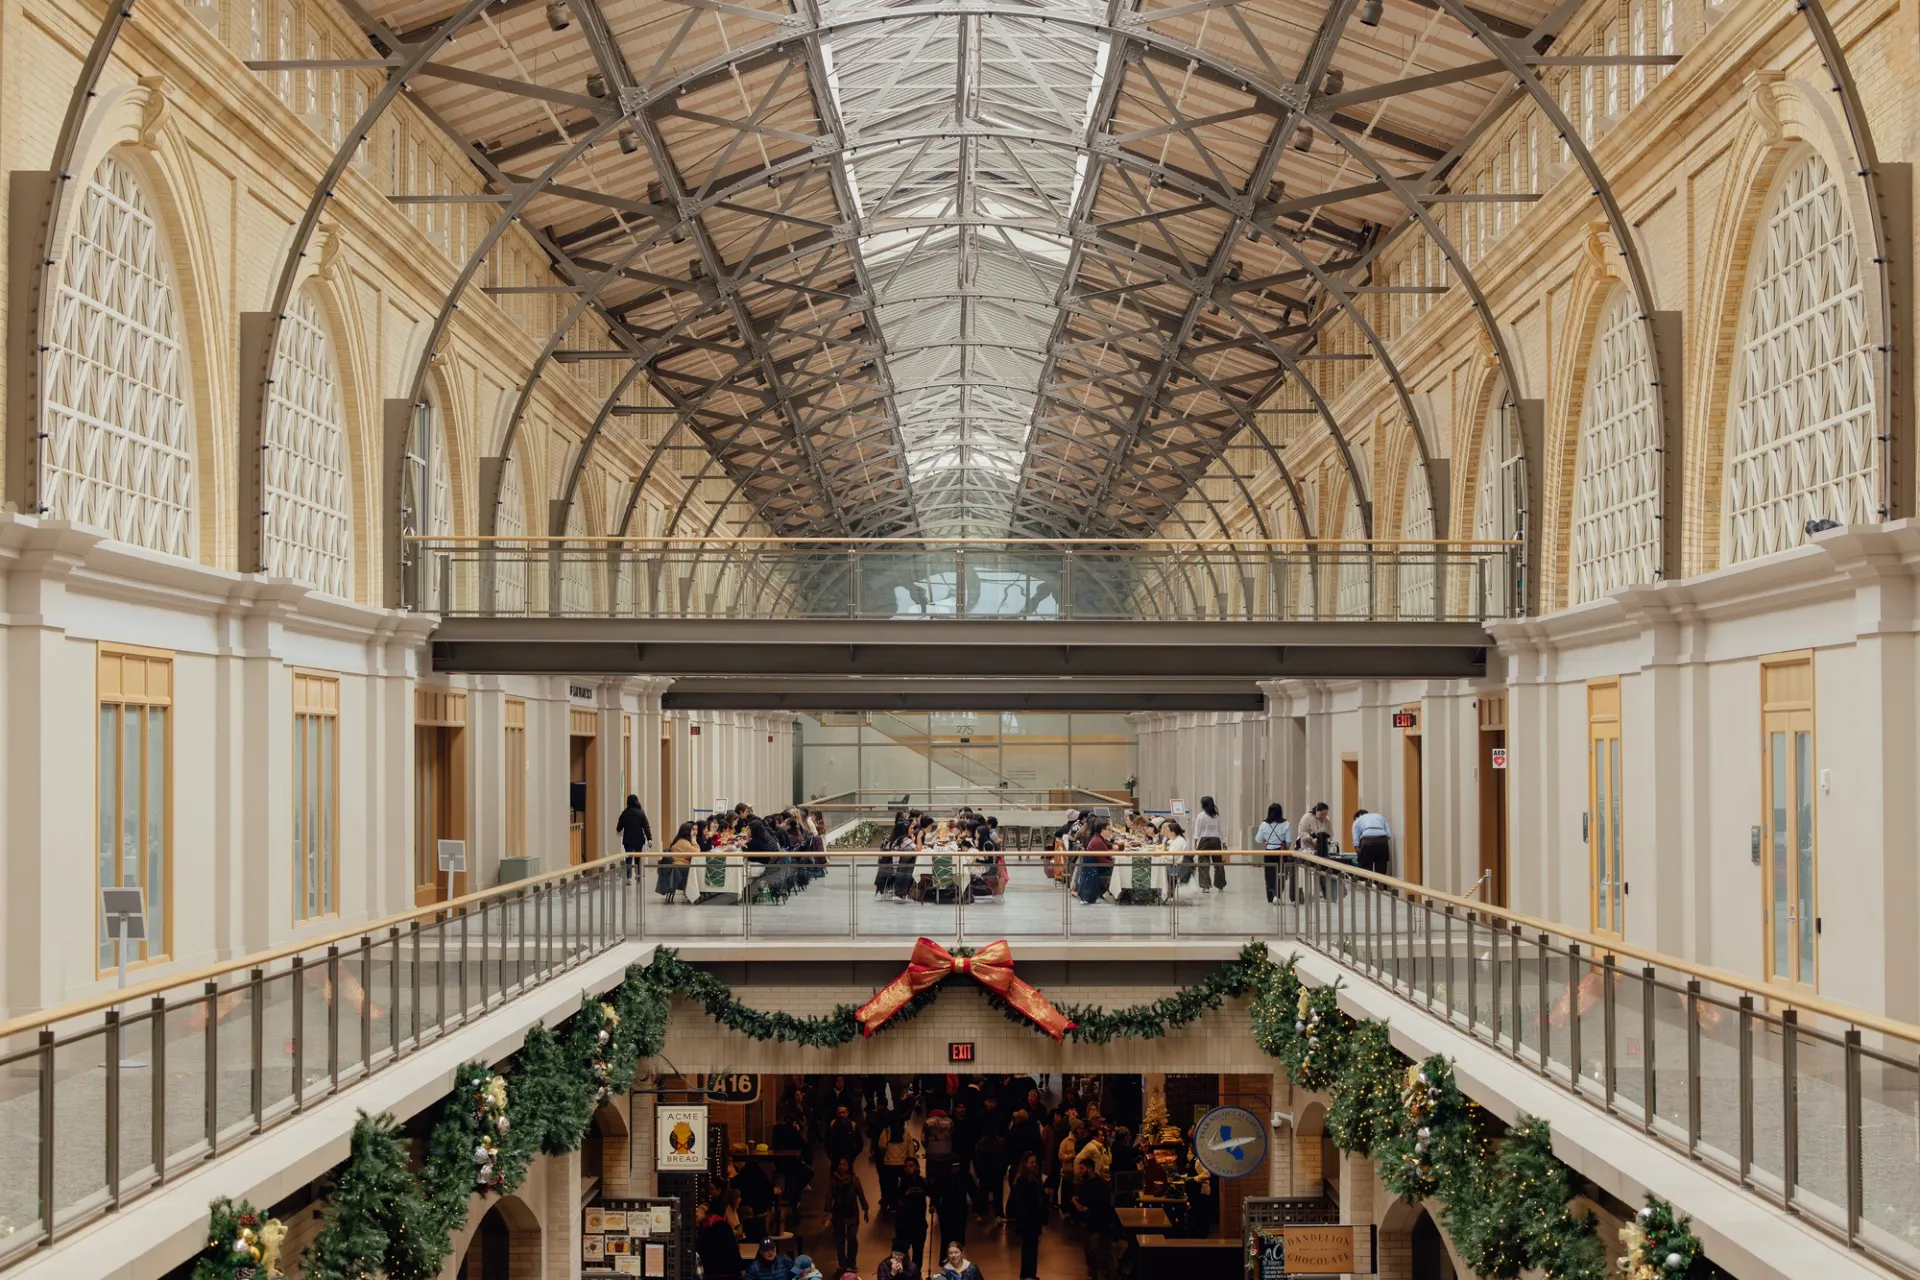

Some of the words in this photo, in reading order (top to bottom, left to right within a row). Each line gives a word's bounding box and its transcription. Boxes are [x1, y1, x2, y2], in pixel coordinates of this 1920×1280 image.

[1396, 714, 1411, 727] EXIT
[956, 725, 974, 735] 275
[952, 1044, 972, 1060] EXIT
[712, 1074, 752, 1093] A16
[667, 1113, 699, 1121] ACME
[667, 1155, 699, 1163] BREAD
[1287, 1233, 1350, 1247] DANDELION
[1287, 1251, 1351, 1265] CHOCOLATE
